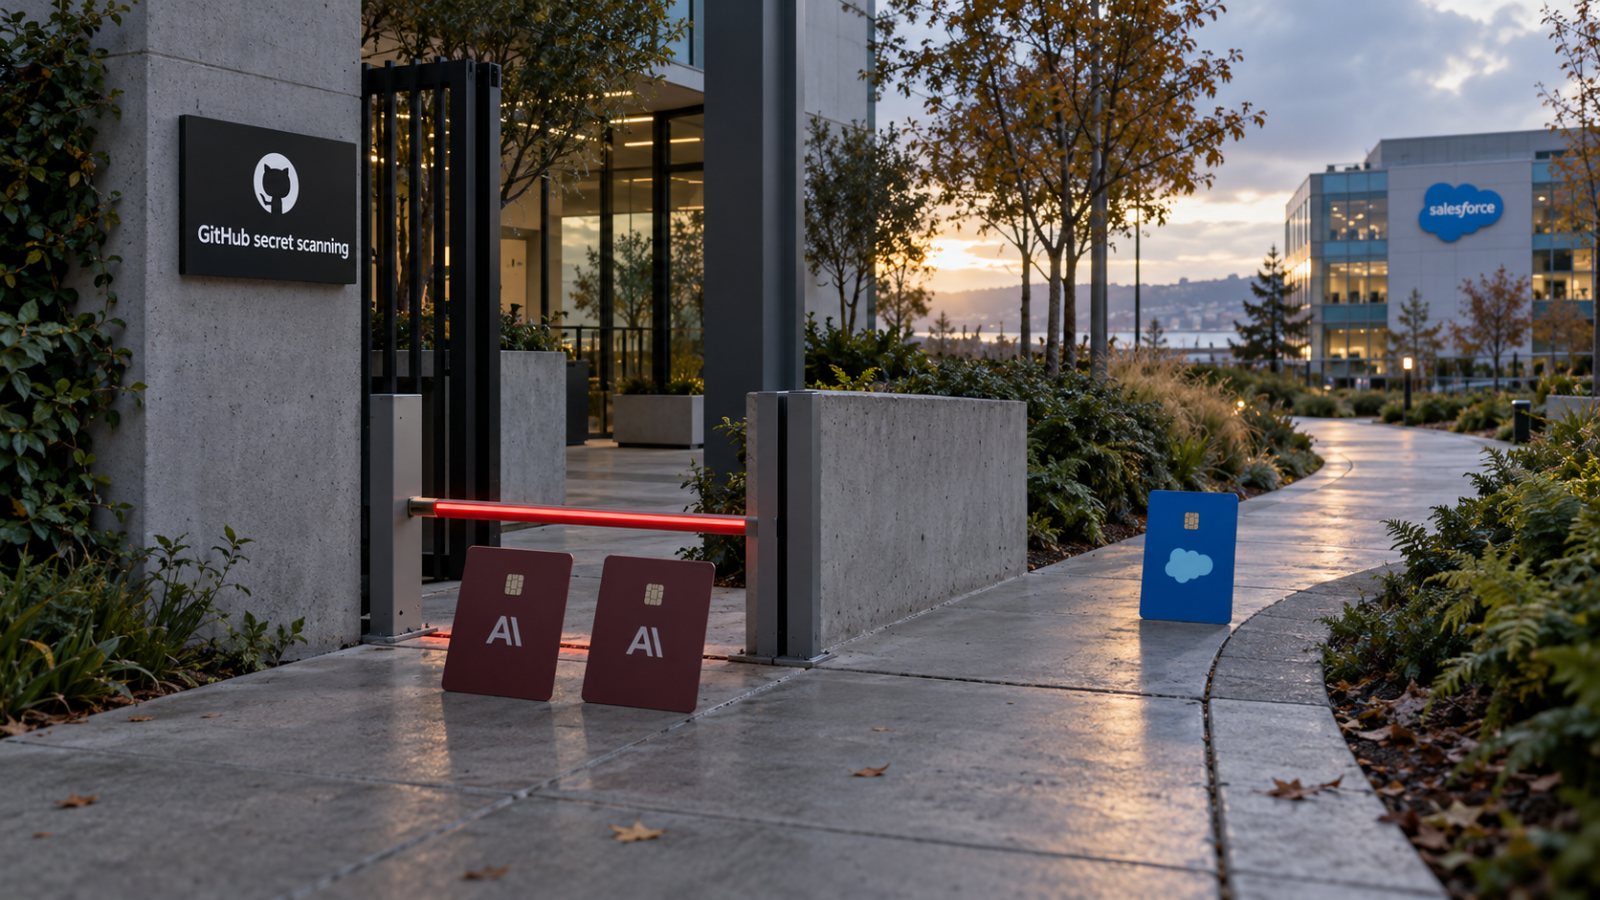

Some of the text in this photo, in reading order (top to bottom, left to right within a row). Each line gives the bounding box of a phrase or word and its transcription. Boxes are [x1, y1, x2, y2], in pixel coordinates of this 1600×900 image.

[1429, 201, 1495, 218] salesforce
[198, 225, 349, 259] GitHub secret scanning
